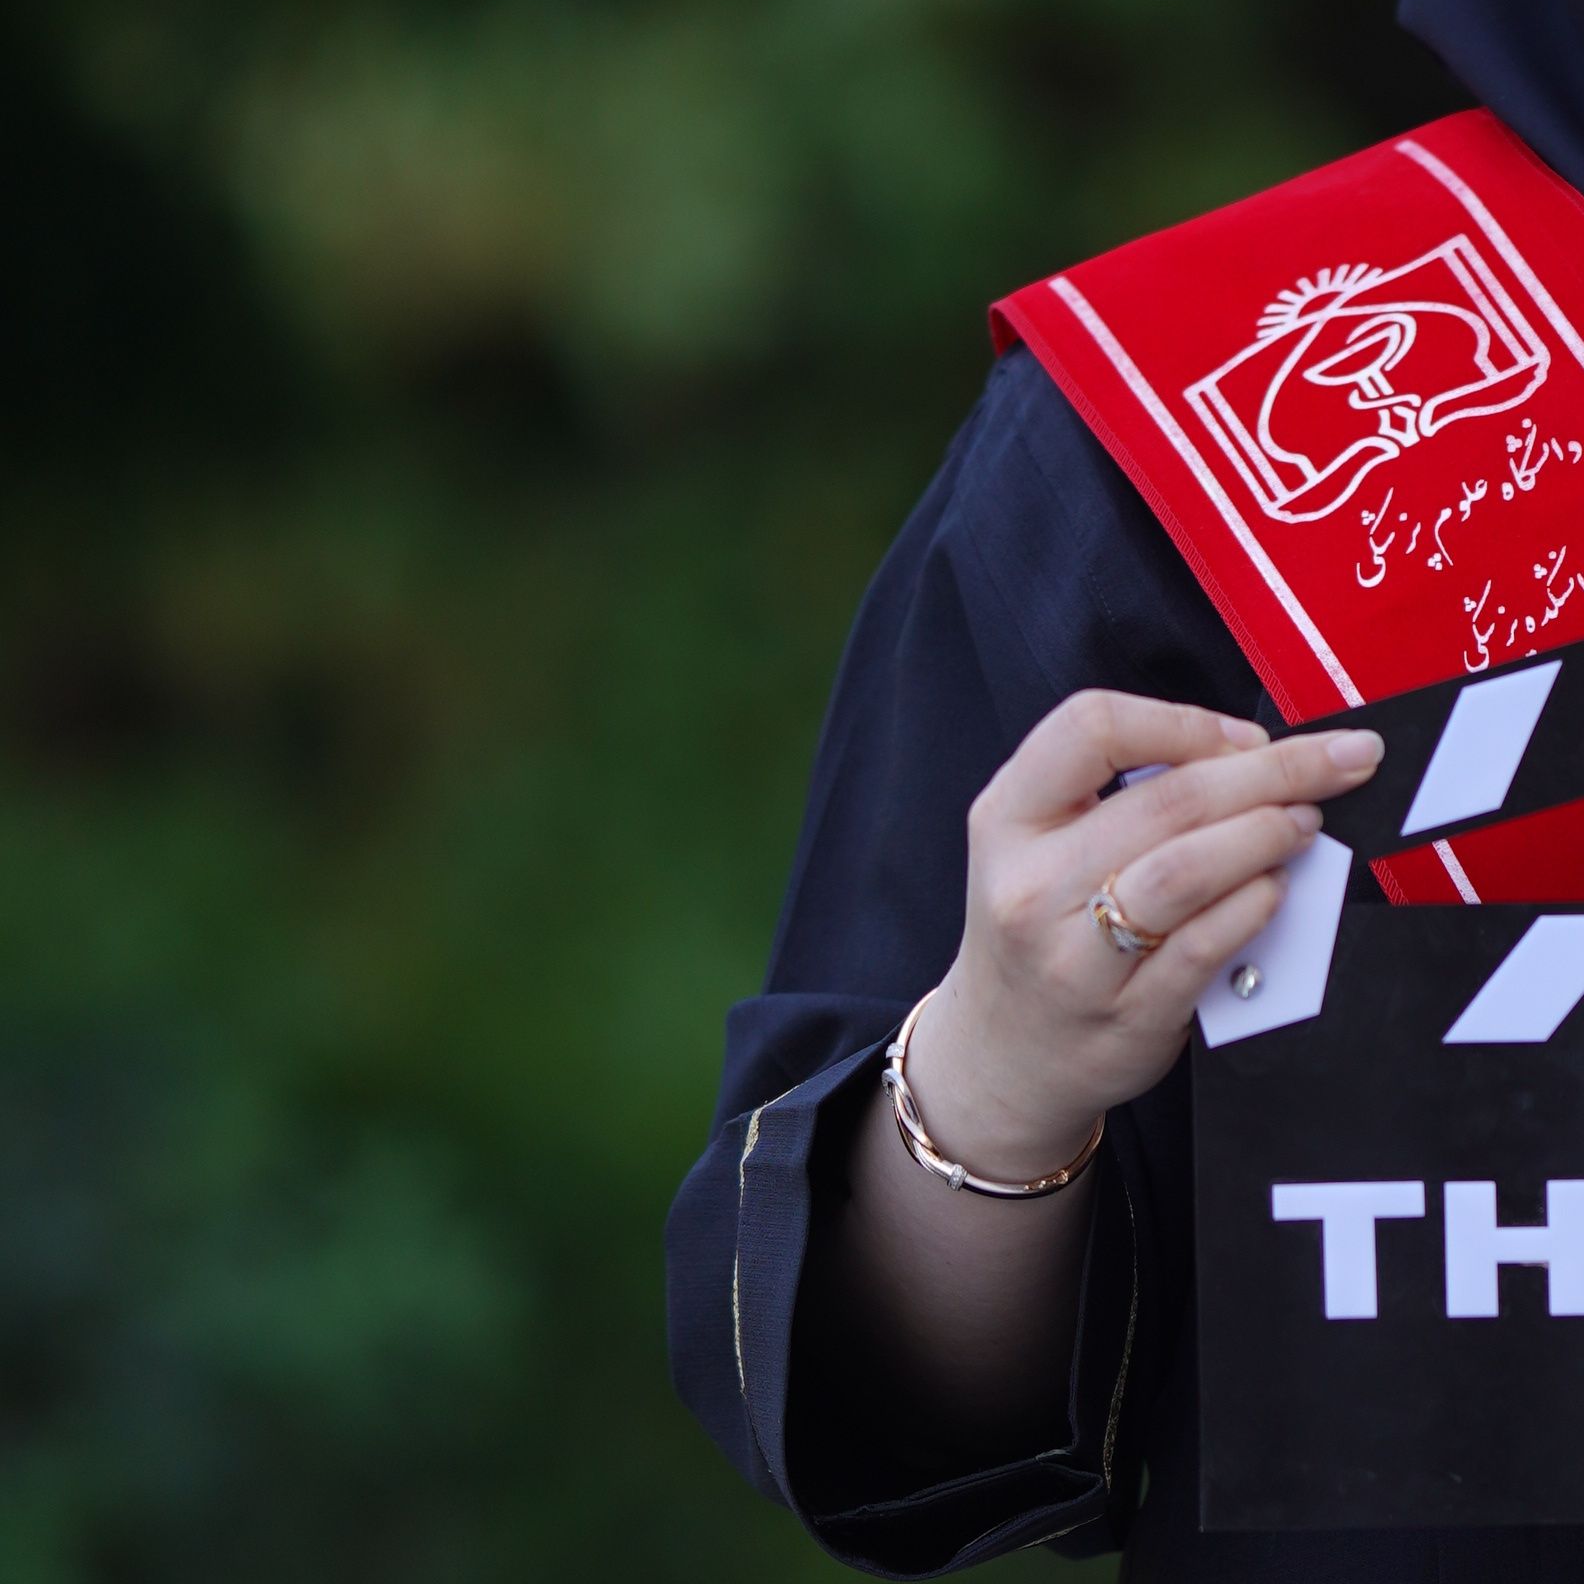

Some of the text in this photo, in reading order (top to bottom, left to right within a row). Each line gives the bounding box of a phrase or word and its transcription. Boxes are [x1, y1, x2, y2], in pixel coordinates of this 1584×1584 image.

[1356, 418, 1582, 588] دانشگاه علوم پزشکی
